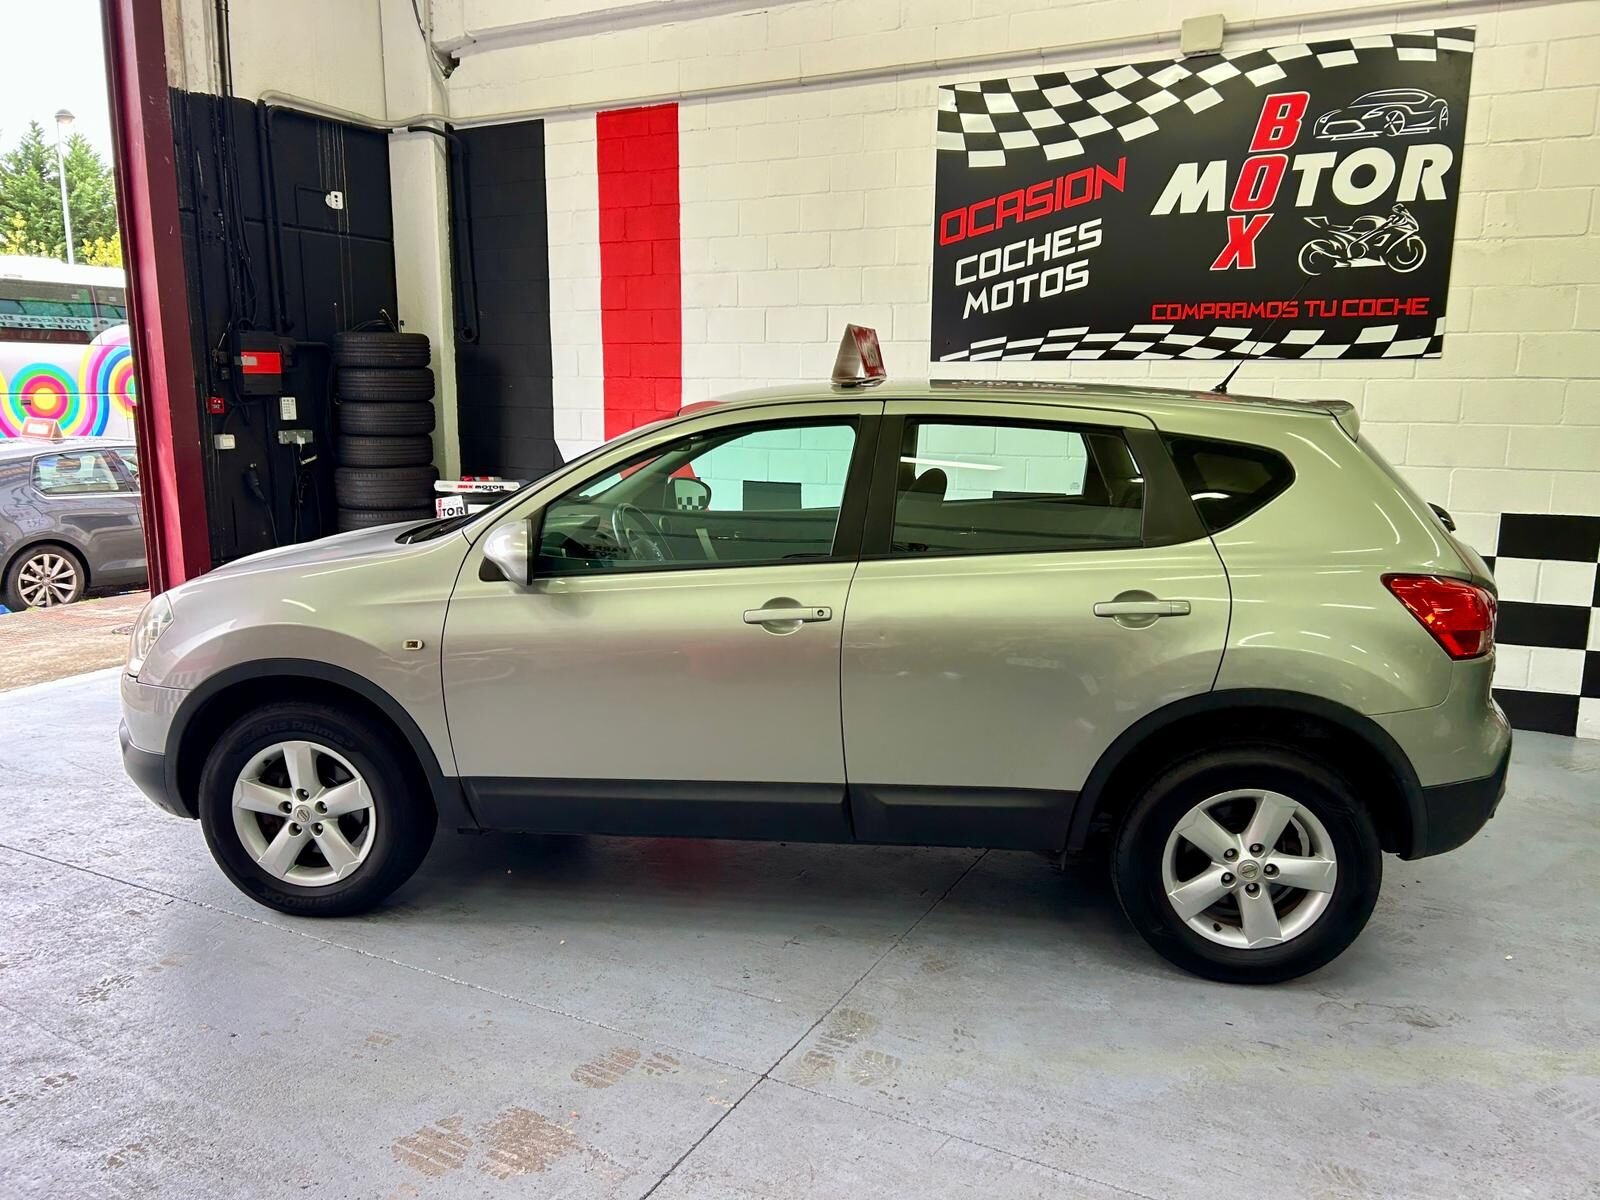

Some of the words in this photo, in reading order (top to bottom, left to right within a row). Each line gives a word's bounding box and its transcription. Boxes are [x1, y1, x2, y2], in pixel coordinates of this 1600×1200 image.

[938, 156, 1128, 247] OCASION
[1210, 90, 1311, 271] BOX
[954, 218, 1104, 287] COCHES
[962, 258, 1091, 320] MOTOS
[1151, 300, 1299, 321] COMPRAMOS
[1305, 300, 1336, 318] TU
[1341, 297, 1430, 317] COCHE
